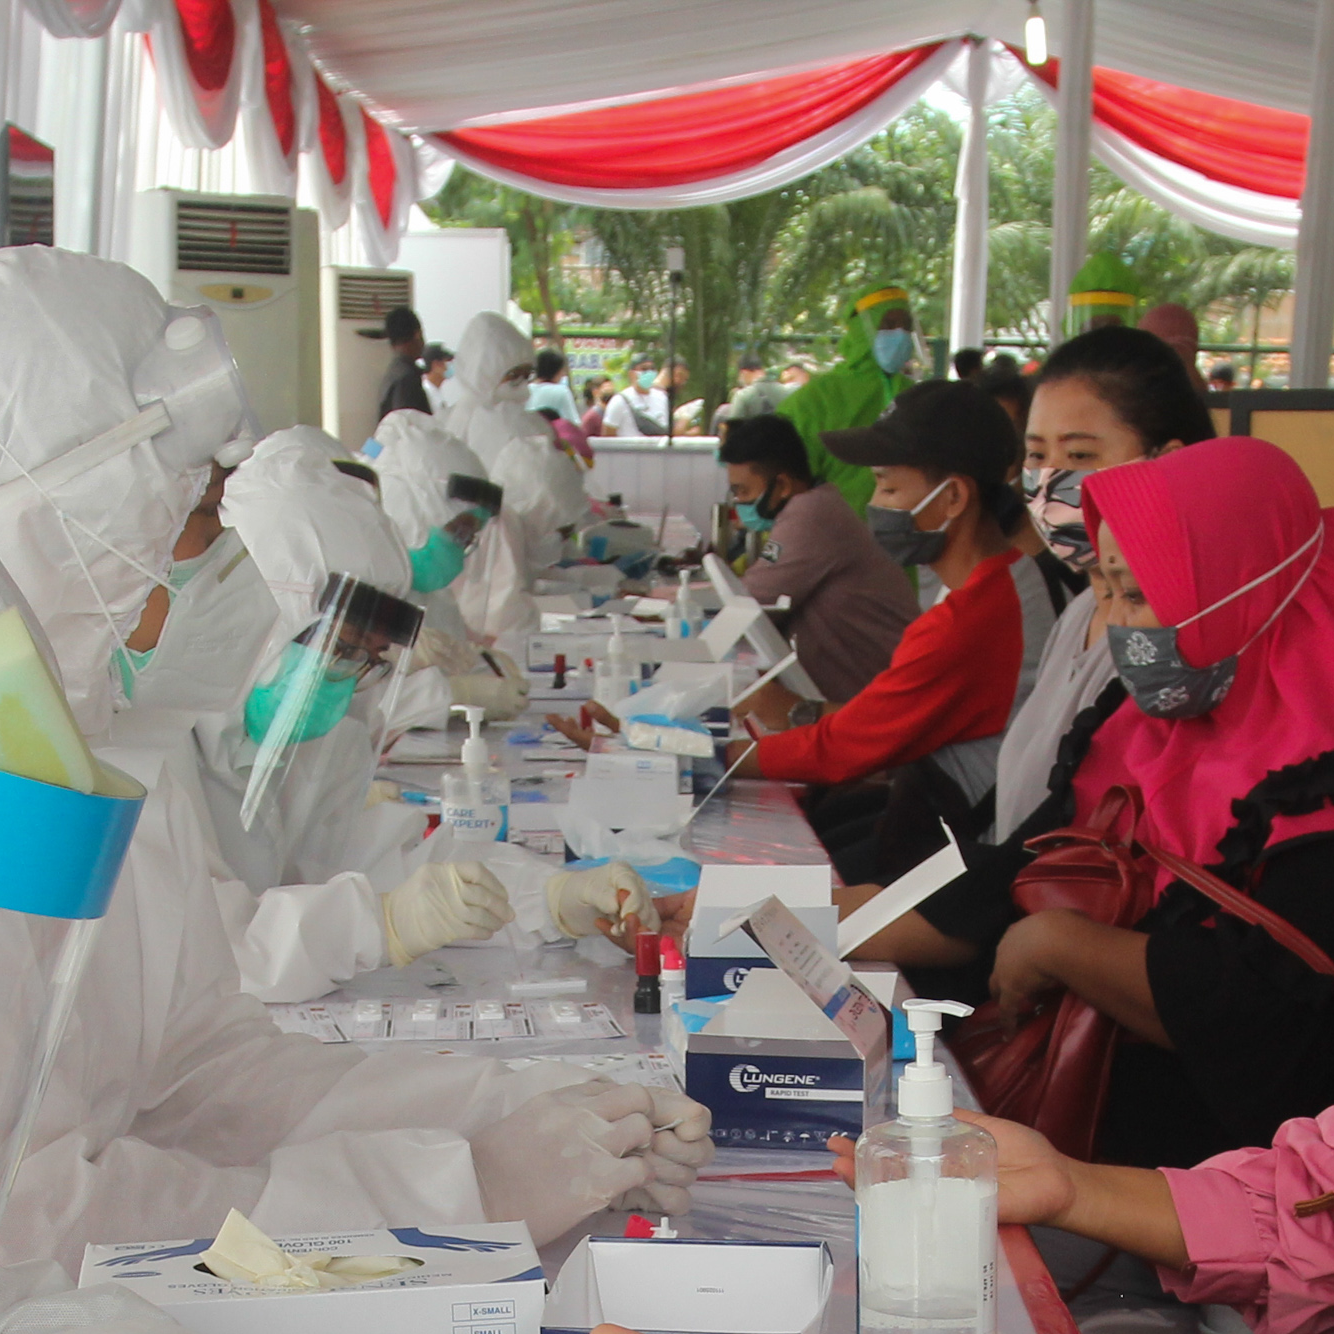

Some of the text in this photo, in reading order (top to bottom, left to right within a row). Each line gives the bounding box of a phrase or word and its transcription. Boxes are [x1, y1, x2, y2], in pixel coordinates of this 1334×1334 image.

[447, 807, 476, 818] CARE
[770, 1089, 809, 1097] RAPID TEST
[278, 1240, 325, 1248] GLOVE
[472, 1306, 512, 1316] X-SMALL
